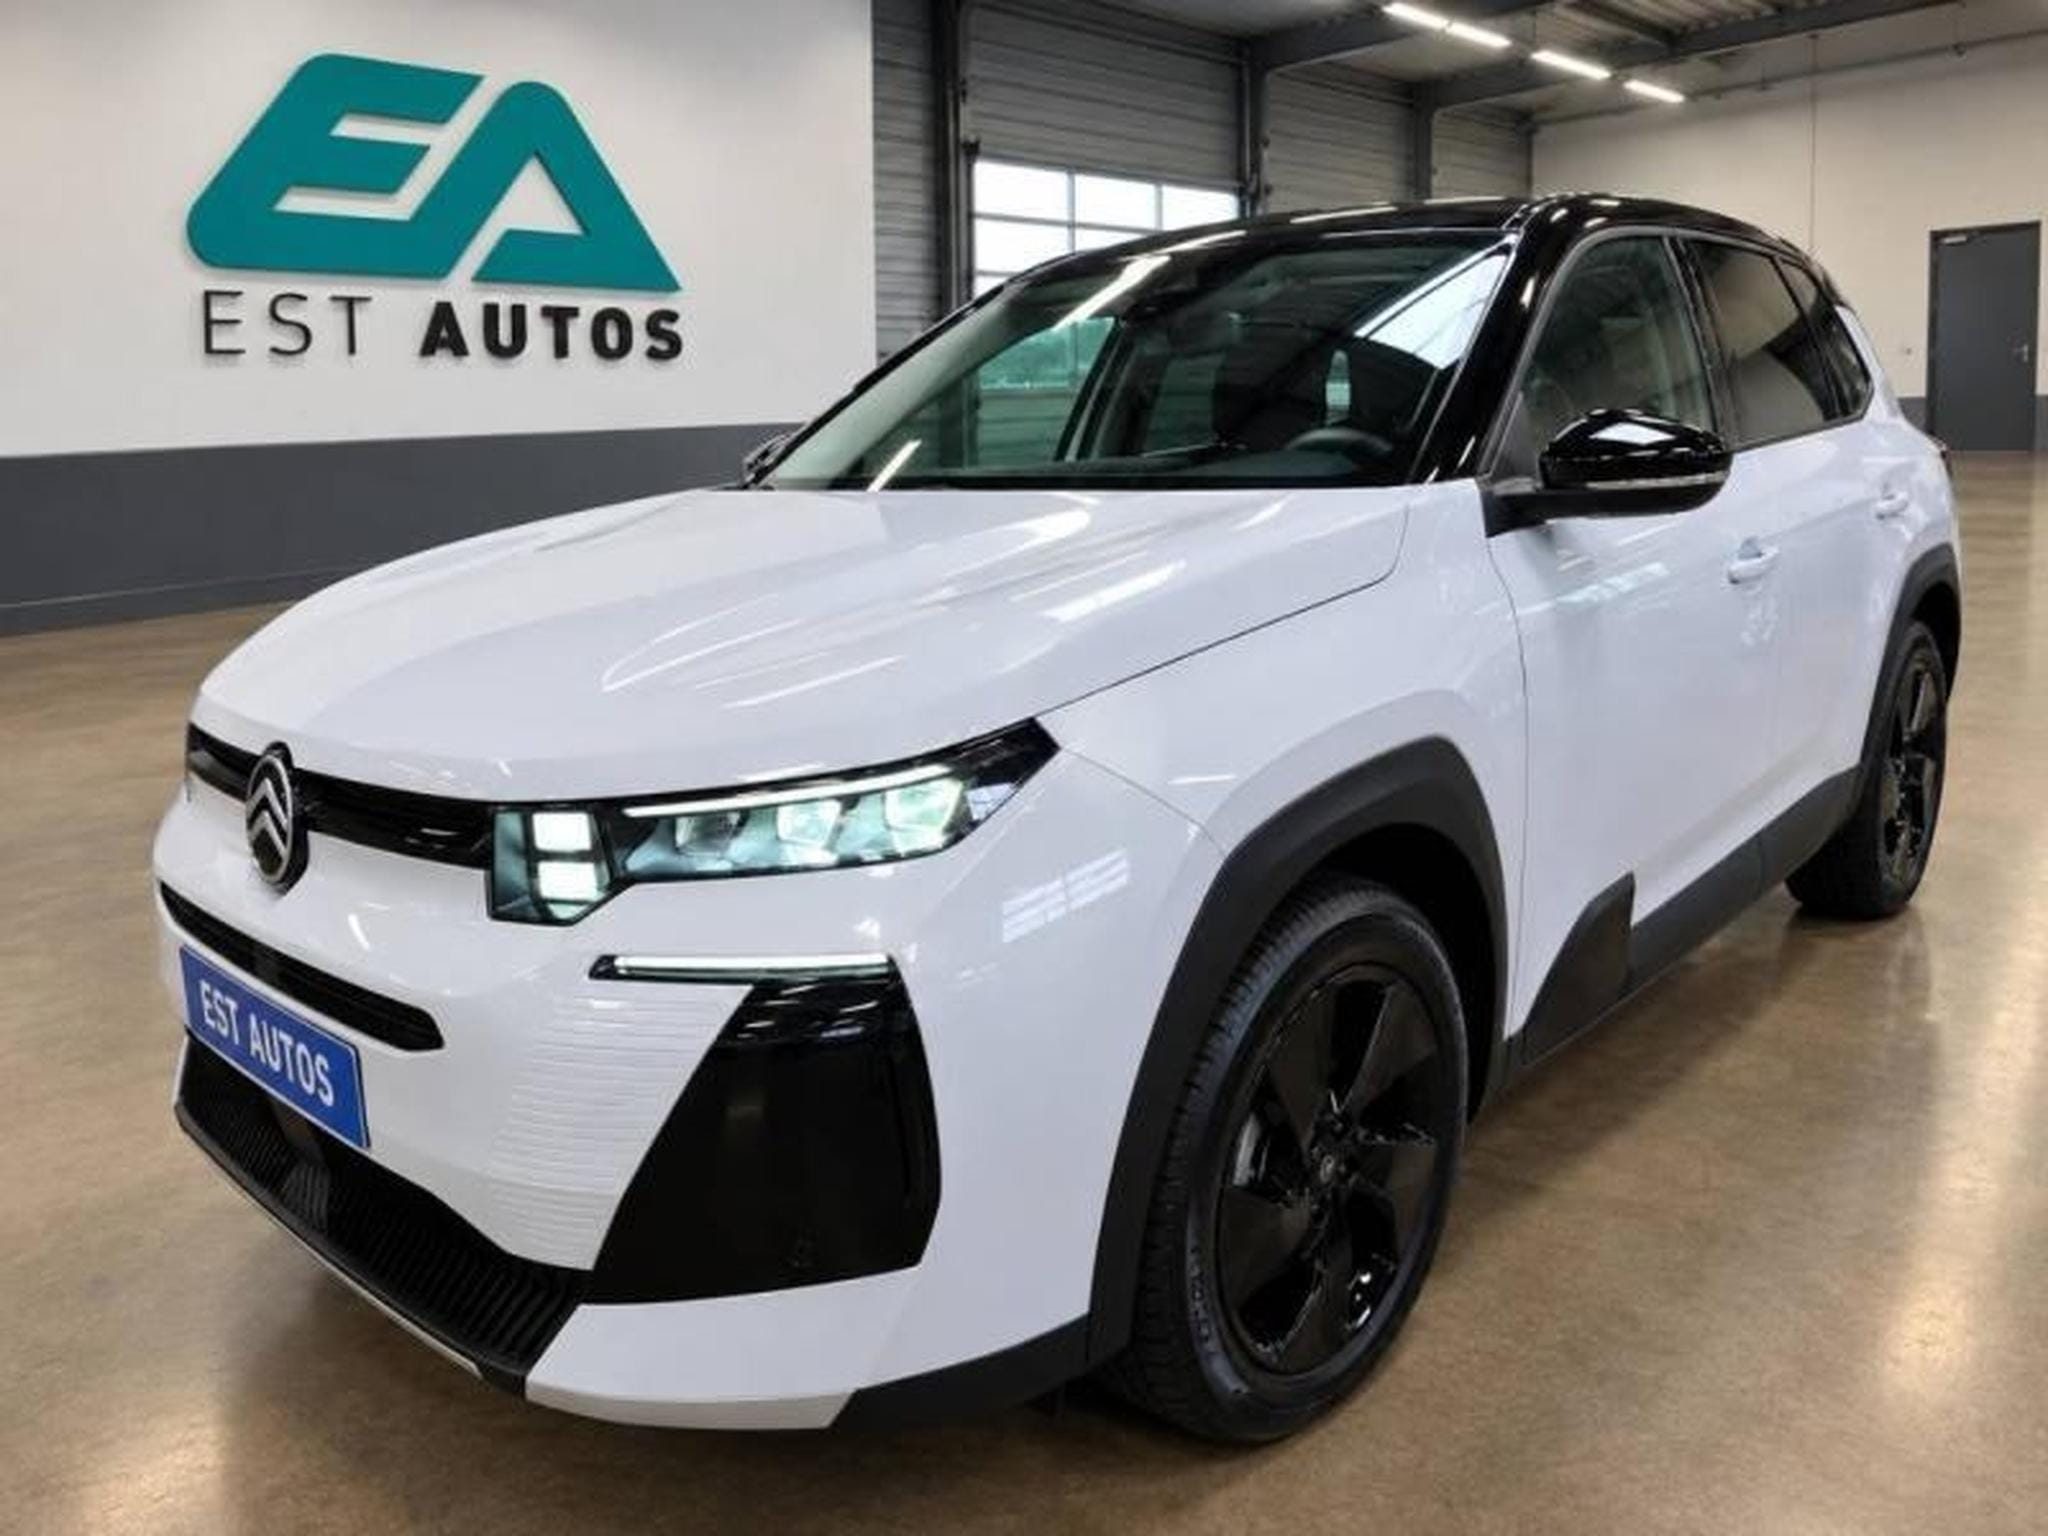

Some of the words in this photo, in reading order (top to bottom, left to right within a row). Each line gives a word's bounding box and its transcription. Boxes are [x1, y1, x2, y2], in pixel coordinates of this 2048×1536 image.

[187, 53, 682, 293] EA
[203, 290, 372, 356] EST
[419, 301, 683, 361] AUTOS
[199, 979, 240, 1045] EST
[250, 1013, 334, 1107] AUTOS
